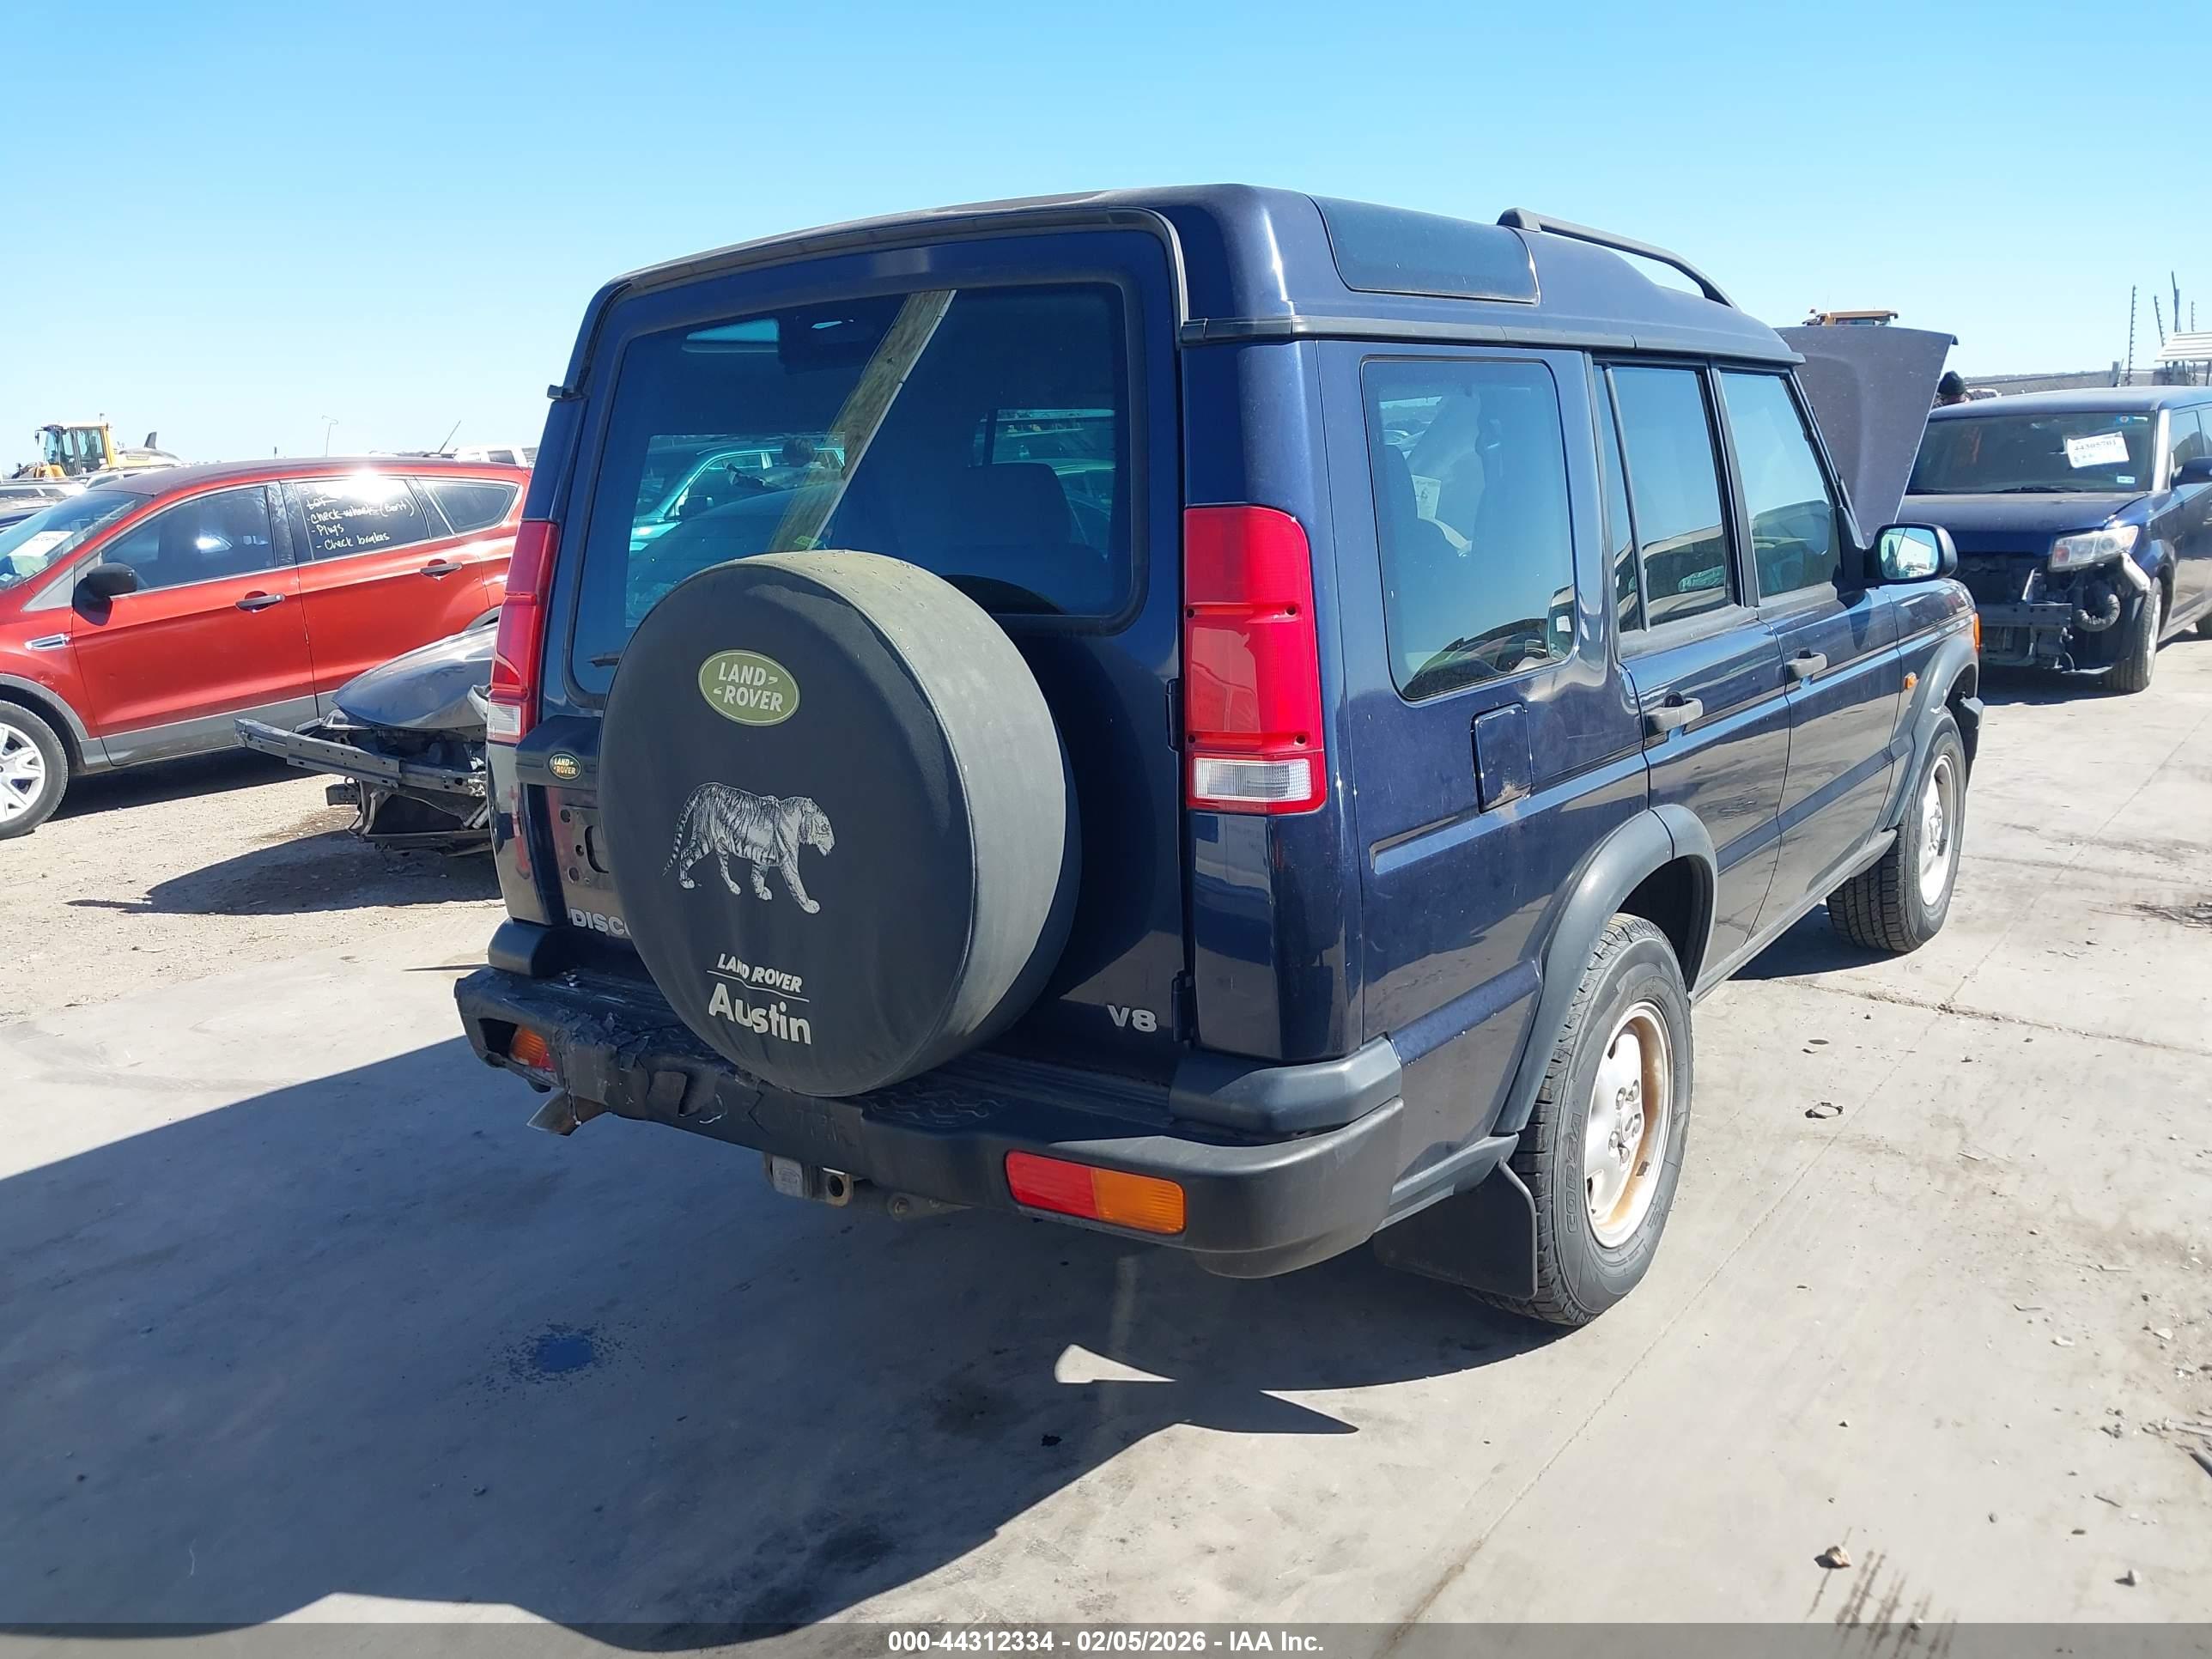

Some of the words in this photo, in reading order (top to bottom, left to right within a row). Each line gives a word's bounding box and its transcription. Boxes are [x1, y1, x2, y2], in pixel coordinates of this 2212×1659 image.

[356, 532, 391, 545] brakes
[718, 661, 768, 687] LAND
[723, 684, 782, 713] ROVER
[554, 757, 570, 767] LAND
[556, 765, 576, 775] ROVER
[570, 908, 631, 936] DISC
[717, 952, 750, 980] LAND
[750, 966, 804, 994] ROVER
[708, 981, 812, 1045] Austin
[1106, 1004, 1158, 1032] V8
[1565, 1112, 1582, 1234] CORSA
